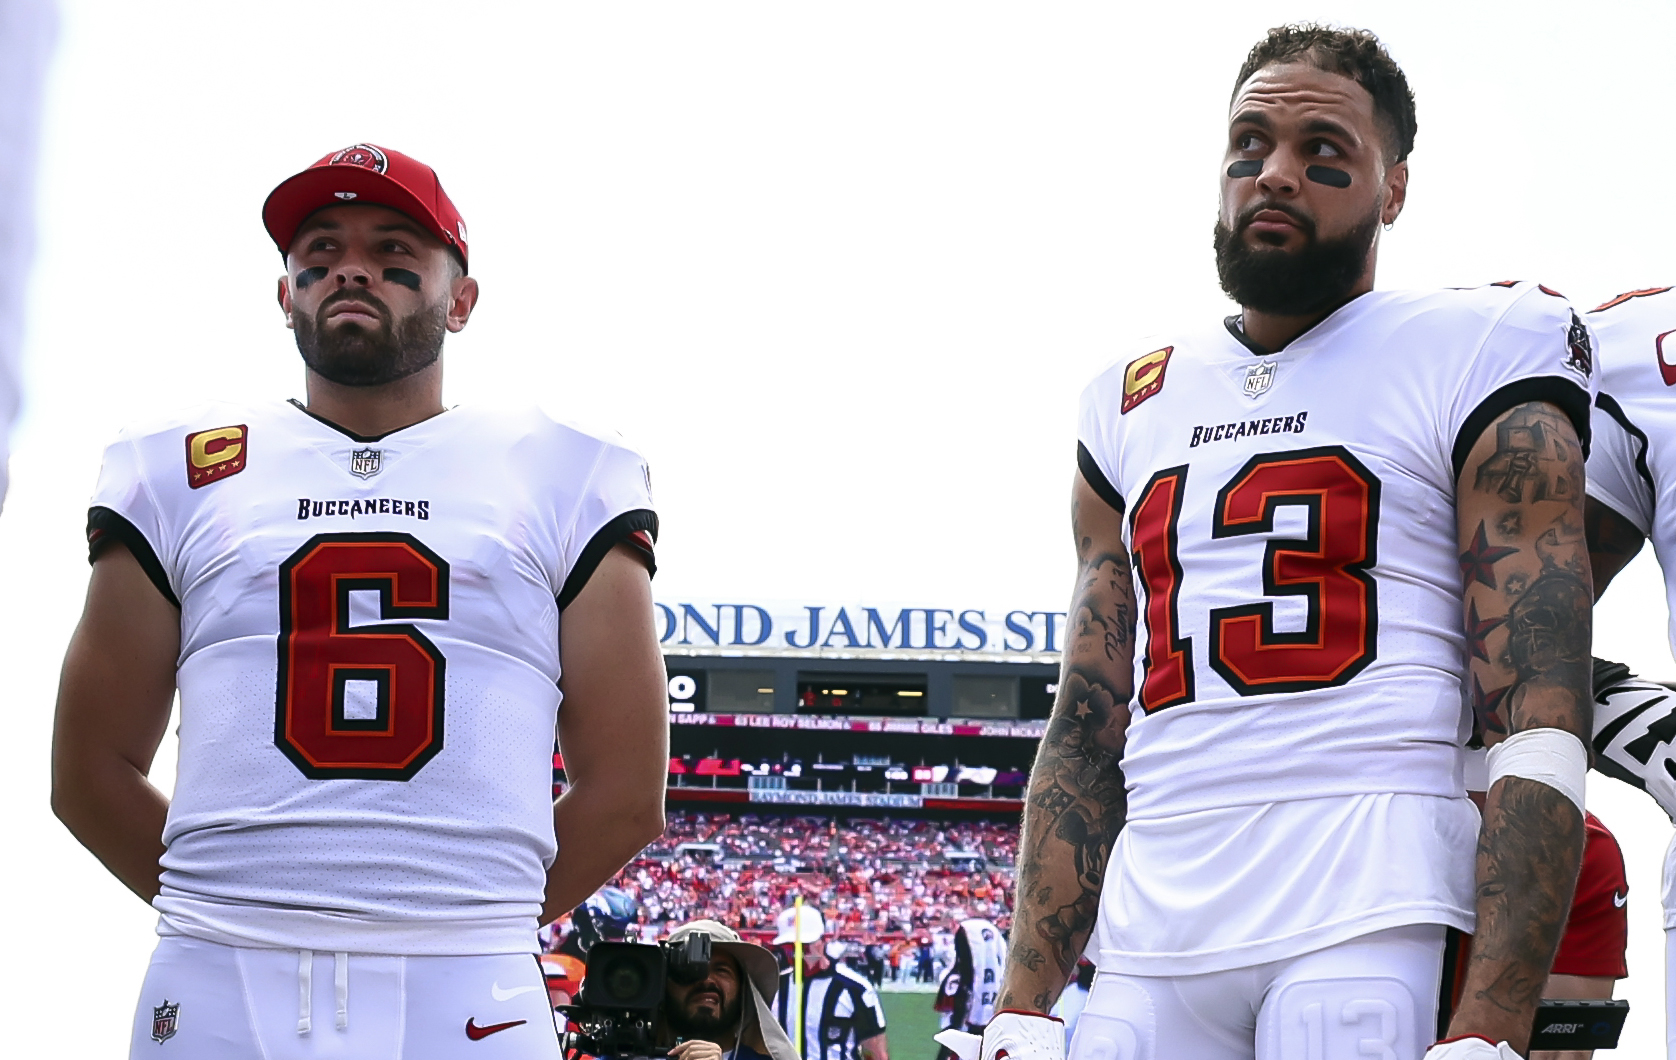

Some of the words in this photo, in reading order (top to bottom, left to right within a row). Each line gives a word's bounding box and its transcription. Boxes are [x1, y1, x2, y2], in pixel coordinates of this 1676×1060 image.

[1126, 350, 1168, 396] C
[1246, 375, 1268, 391] NFL
[190, 426, 243, 469] C
[354, 458, 378, 473] NFL
[1128, 444, 1383, 717] 13
[784, 605, 988, 651] JAMES
[273, 531, 451, 782] 6
[1541, 1023, 1578, 1034] ARRI
